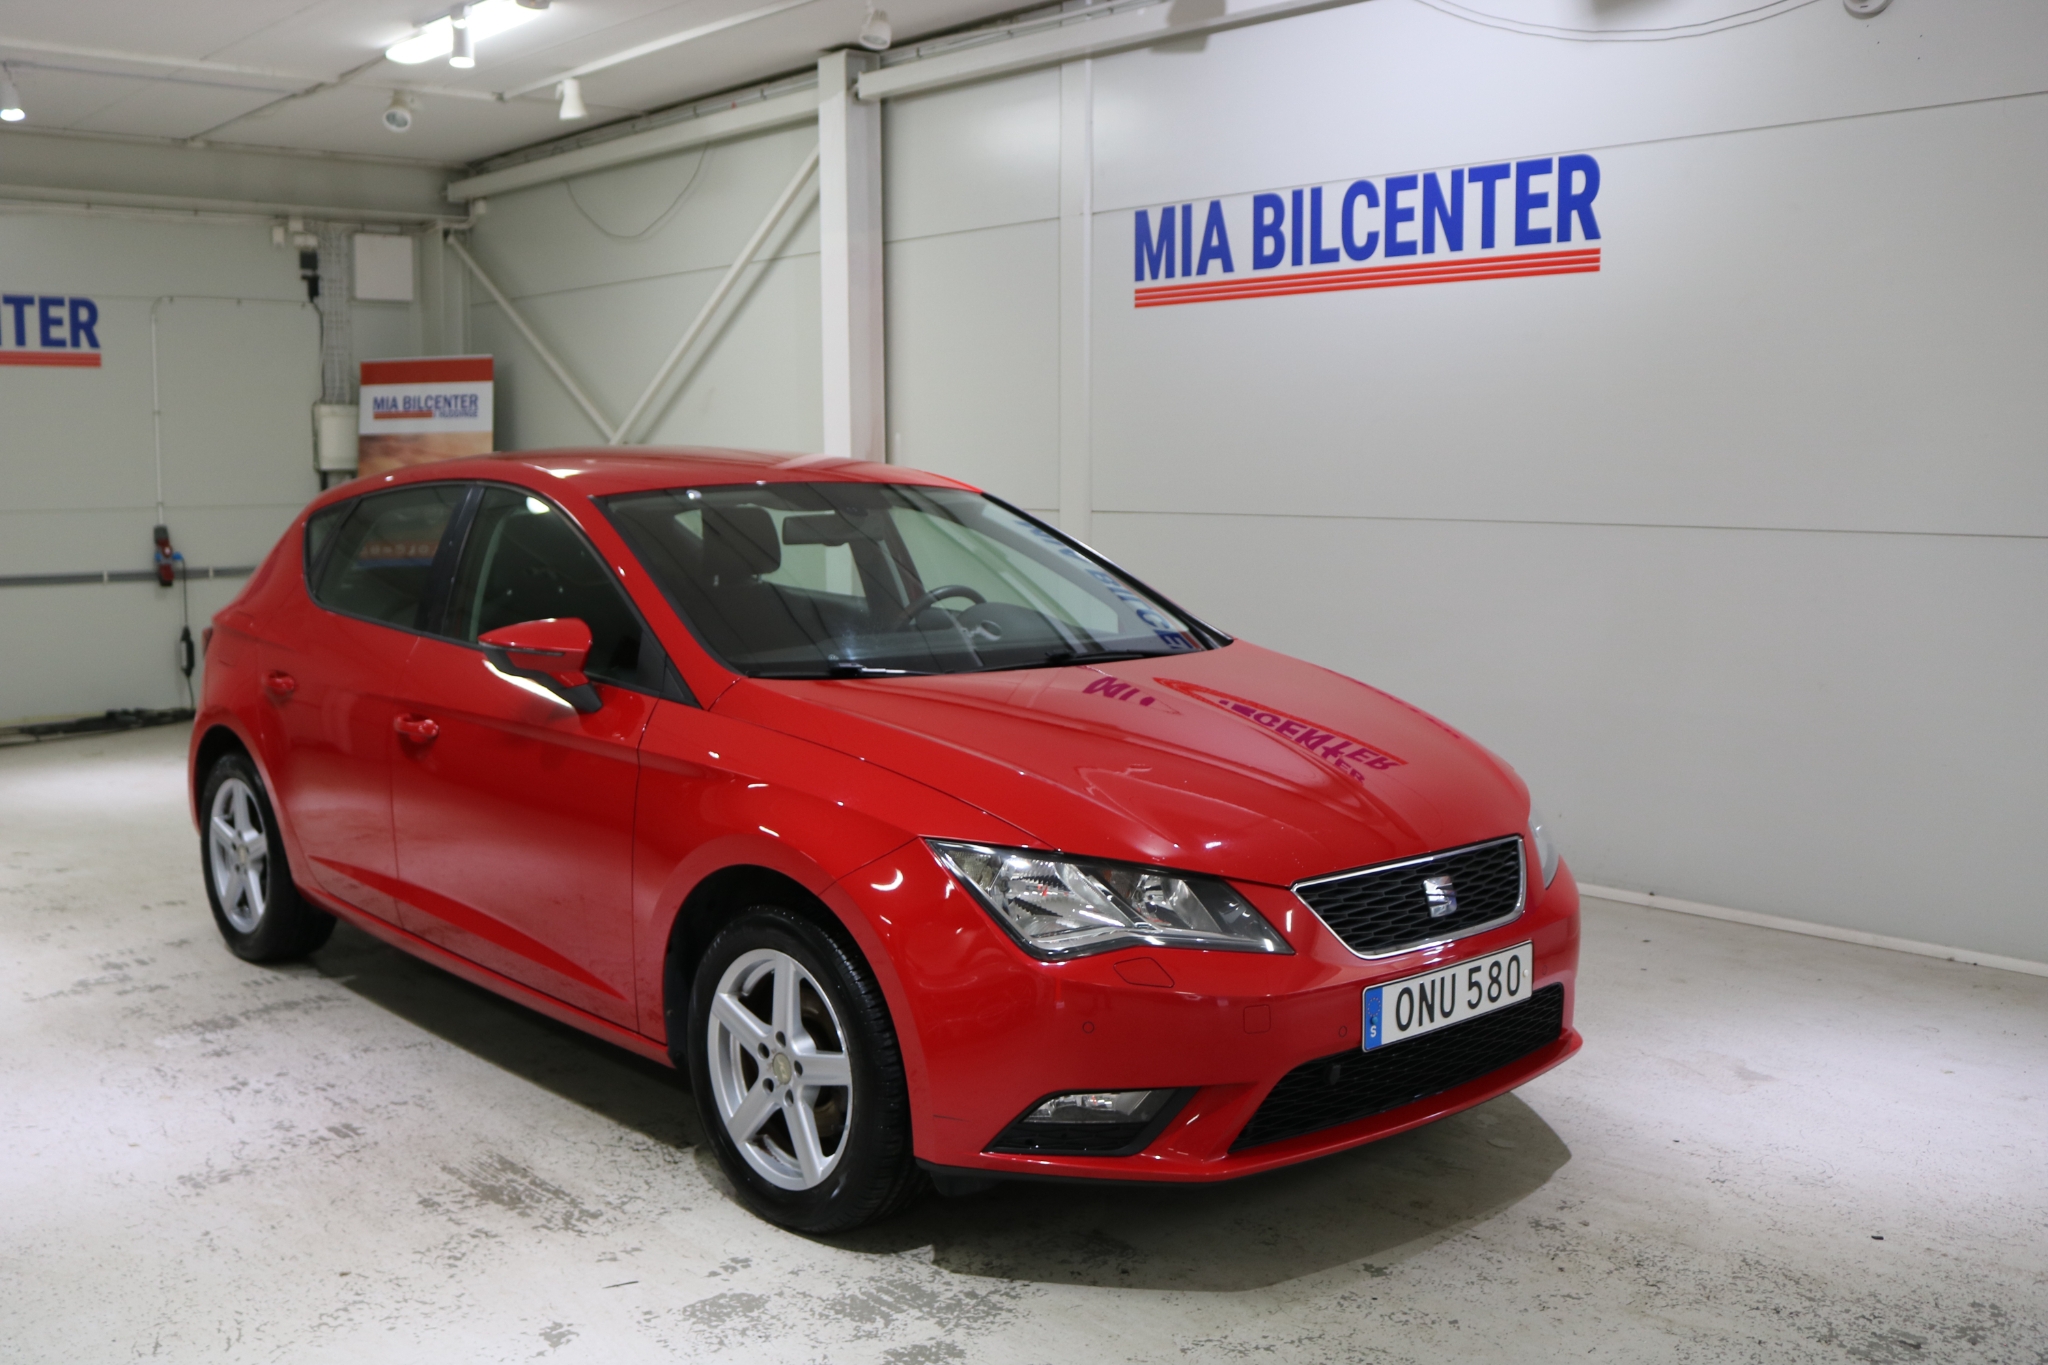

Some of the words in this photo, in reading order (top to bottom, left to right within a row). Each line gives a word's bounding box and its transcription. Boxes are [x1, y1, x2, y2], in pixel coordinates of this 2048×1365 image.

[1134, 200, 1235, 282] MIA
[1252, 153, 1602, 271] BILCENTER
[0, 294, 101, 349] TER
[373, 396, 399, 411] MIA
[403, 394, 479, 411] BILCENTER
[1395, 972, 1457, 1032] ONU
[1466, 954, 1522, 1010] 580
[1369, 1025, 1378, 1039] S
